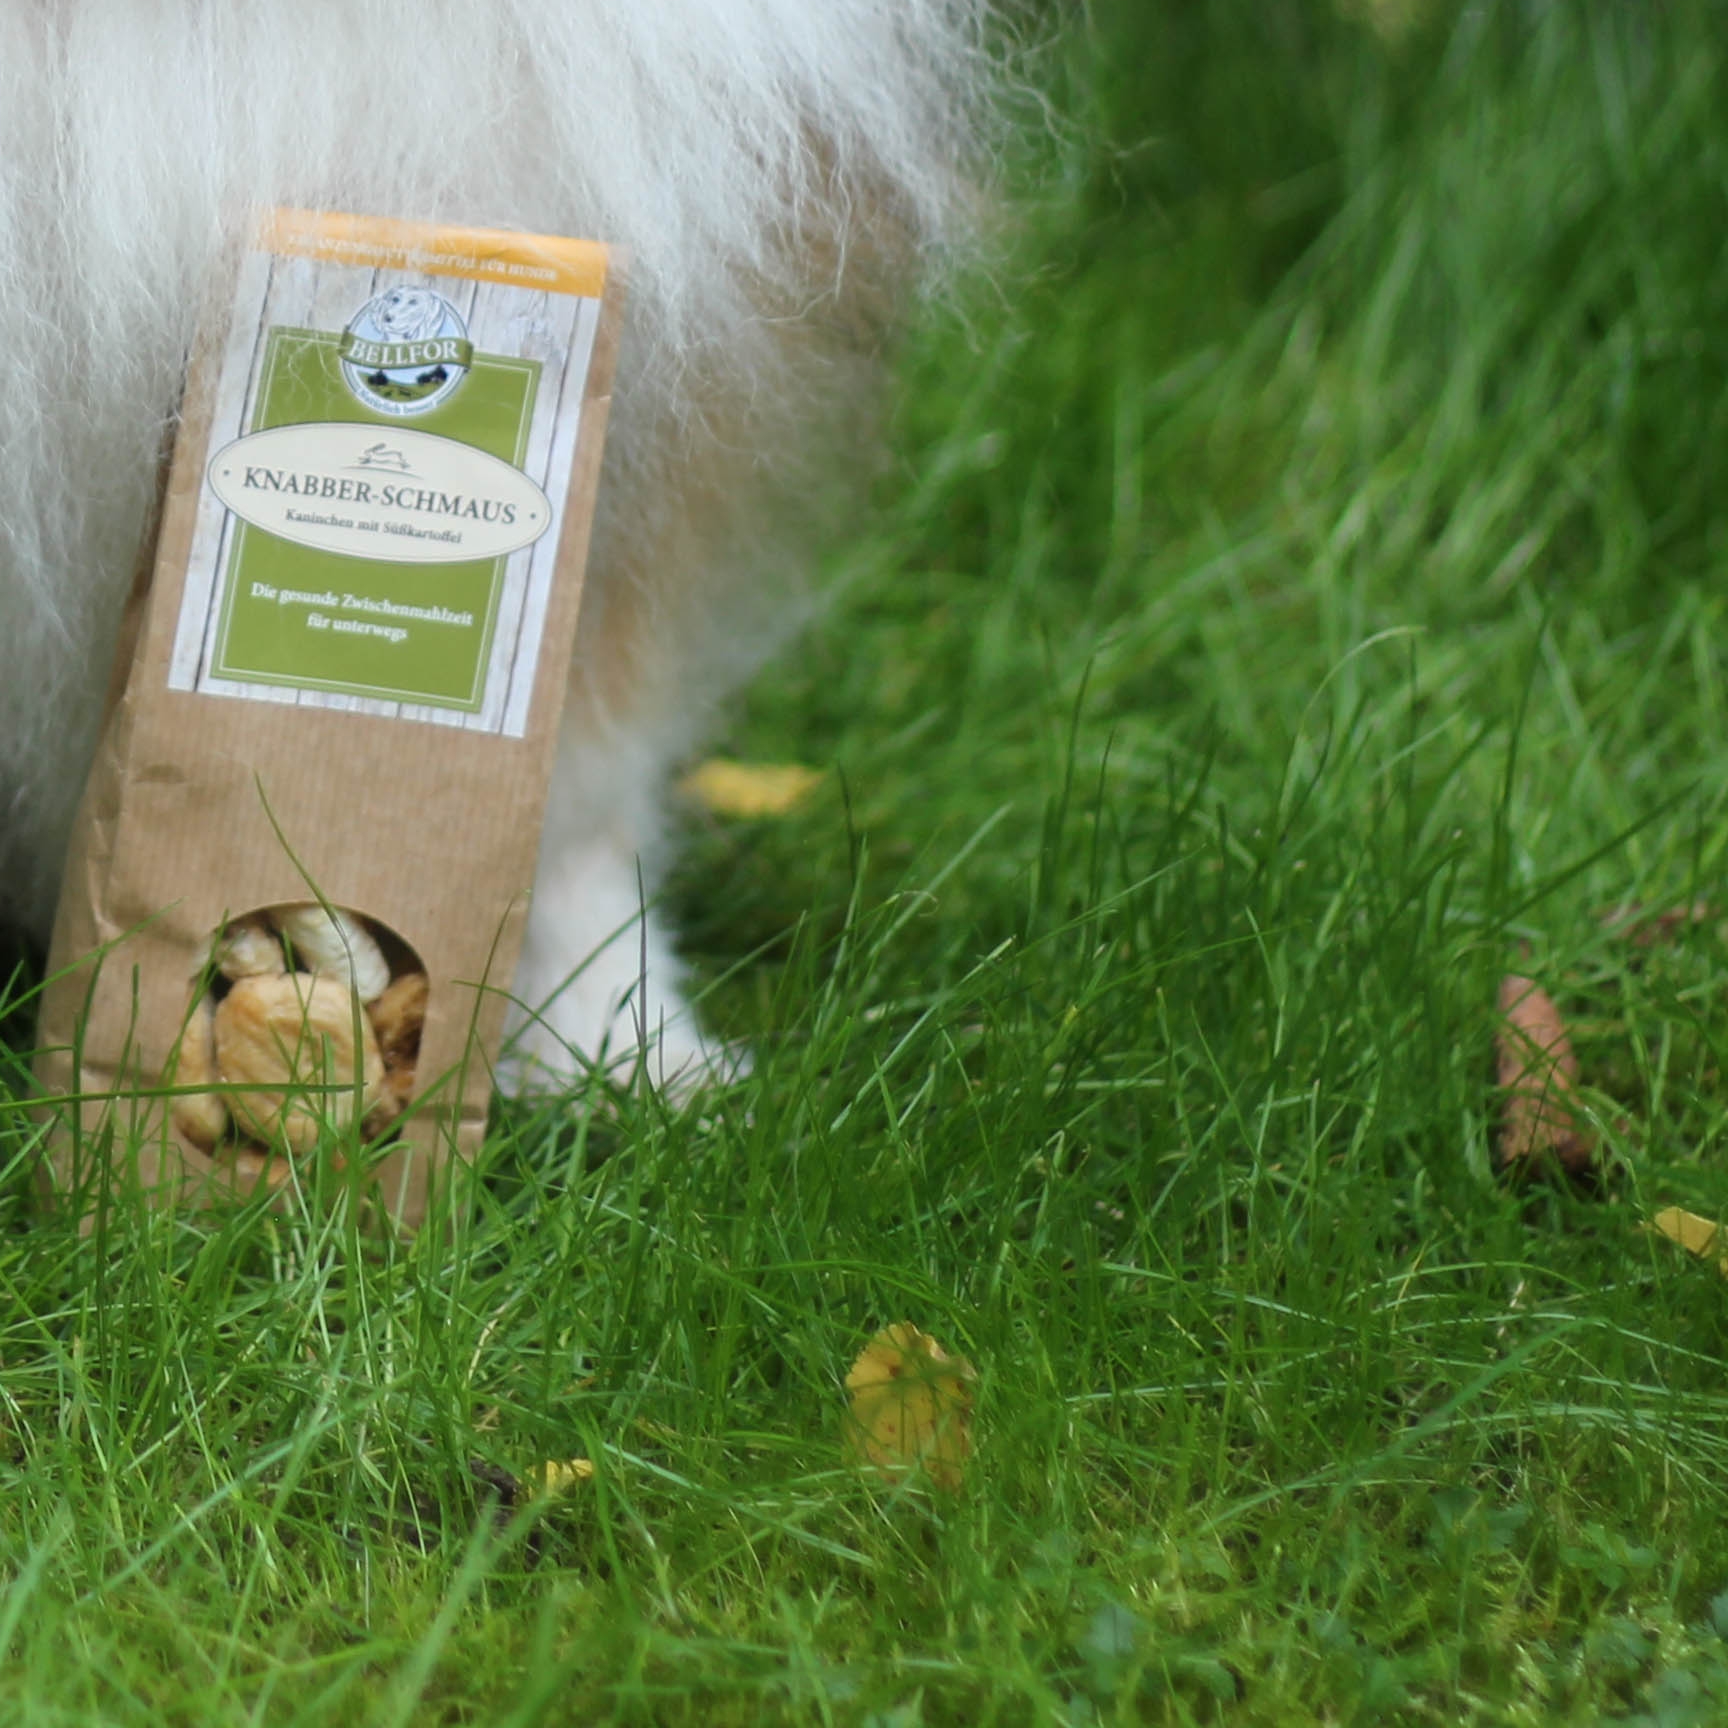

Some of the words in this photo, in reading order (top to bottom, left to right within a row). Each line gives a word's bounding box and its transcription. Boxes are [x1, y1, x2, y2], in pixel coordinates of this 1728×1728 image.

[348, 339, 460, 365] BELLFOR
[243, 466, 517, 525] KNABBER-SCHMAUS
[285, 508, 354, 530] Kaninchen
[357, 517, 380, 533] mit
[383, 521, 463, 545] Süßkartoffel
[251, 582, 277, 599] Die
[279, 588, 339, 608] gesunde
[341, 593, 474, 627] Zwischenmahlzeit
[306, 613, 330, 631] für
[332, 618, 409, 643] unterwegs
